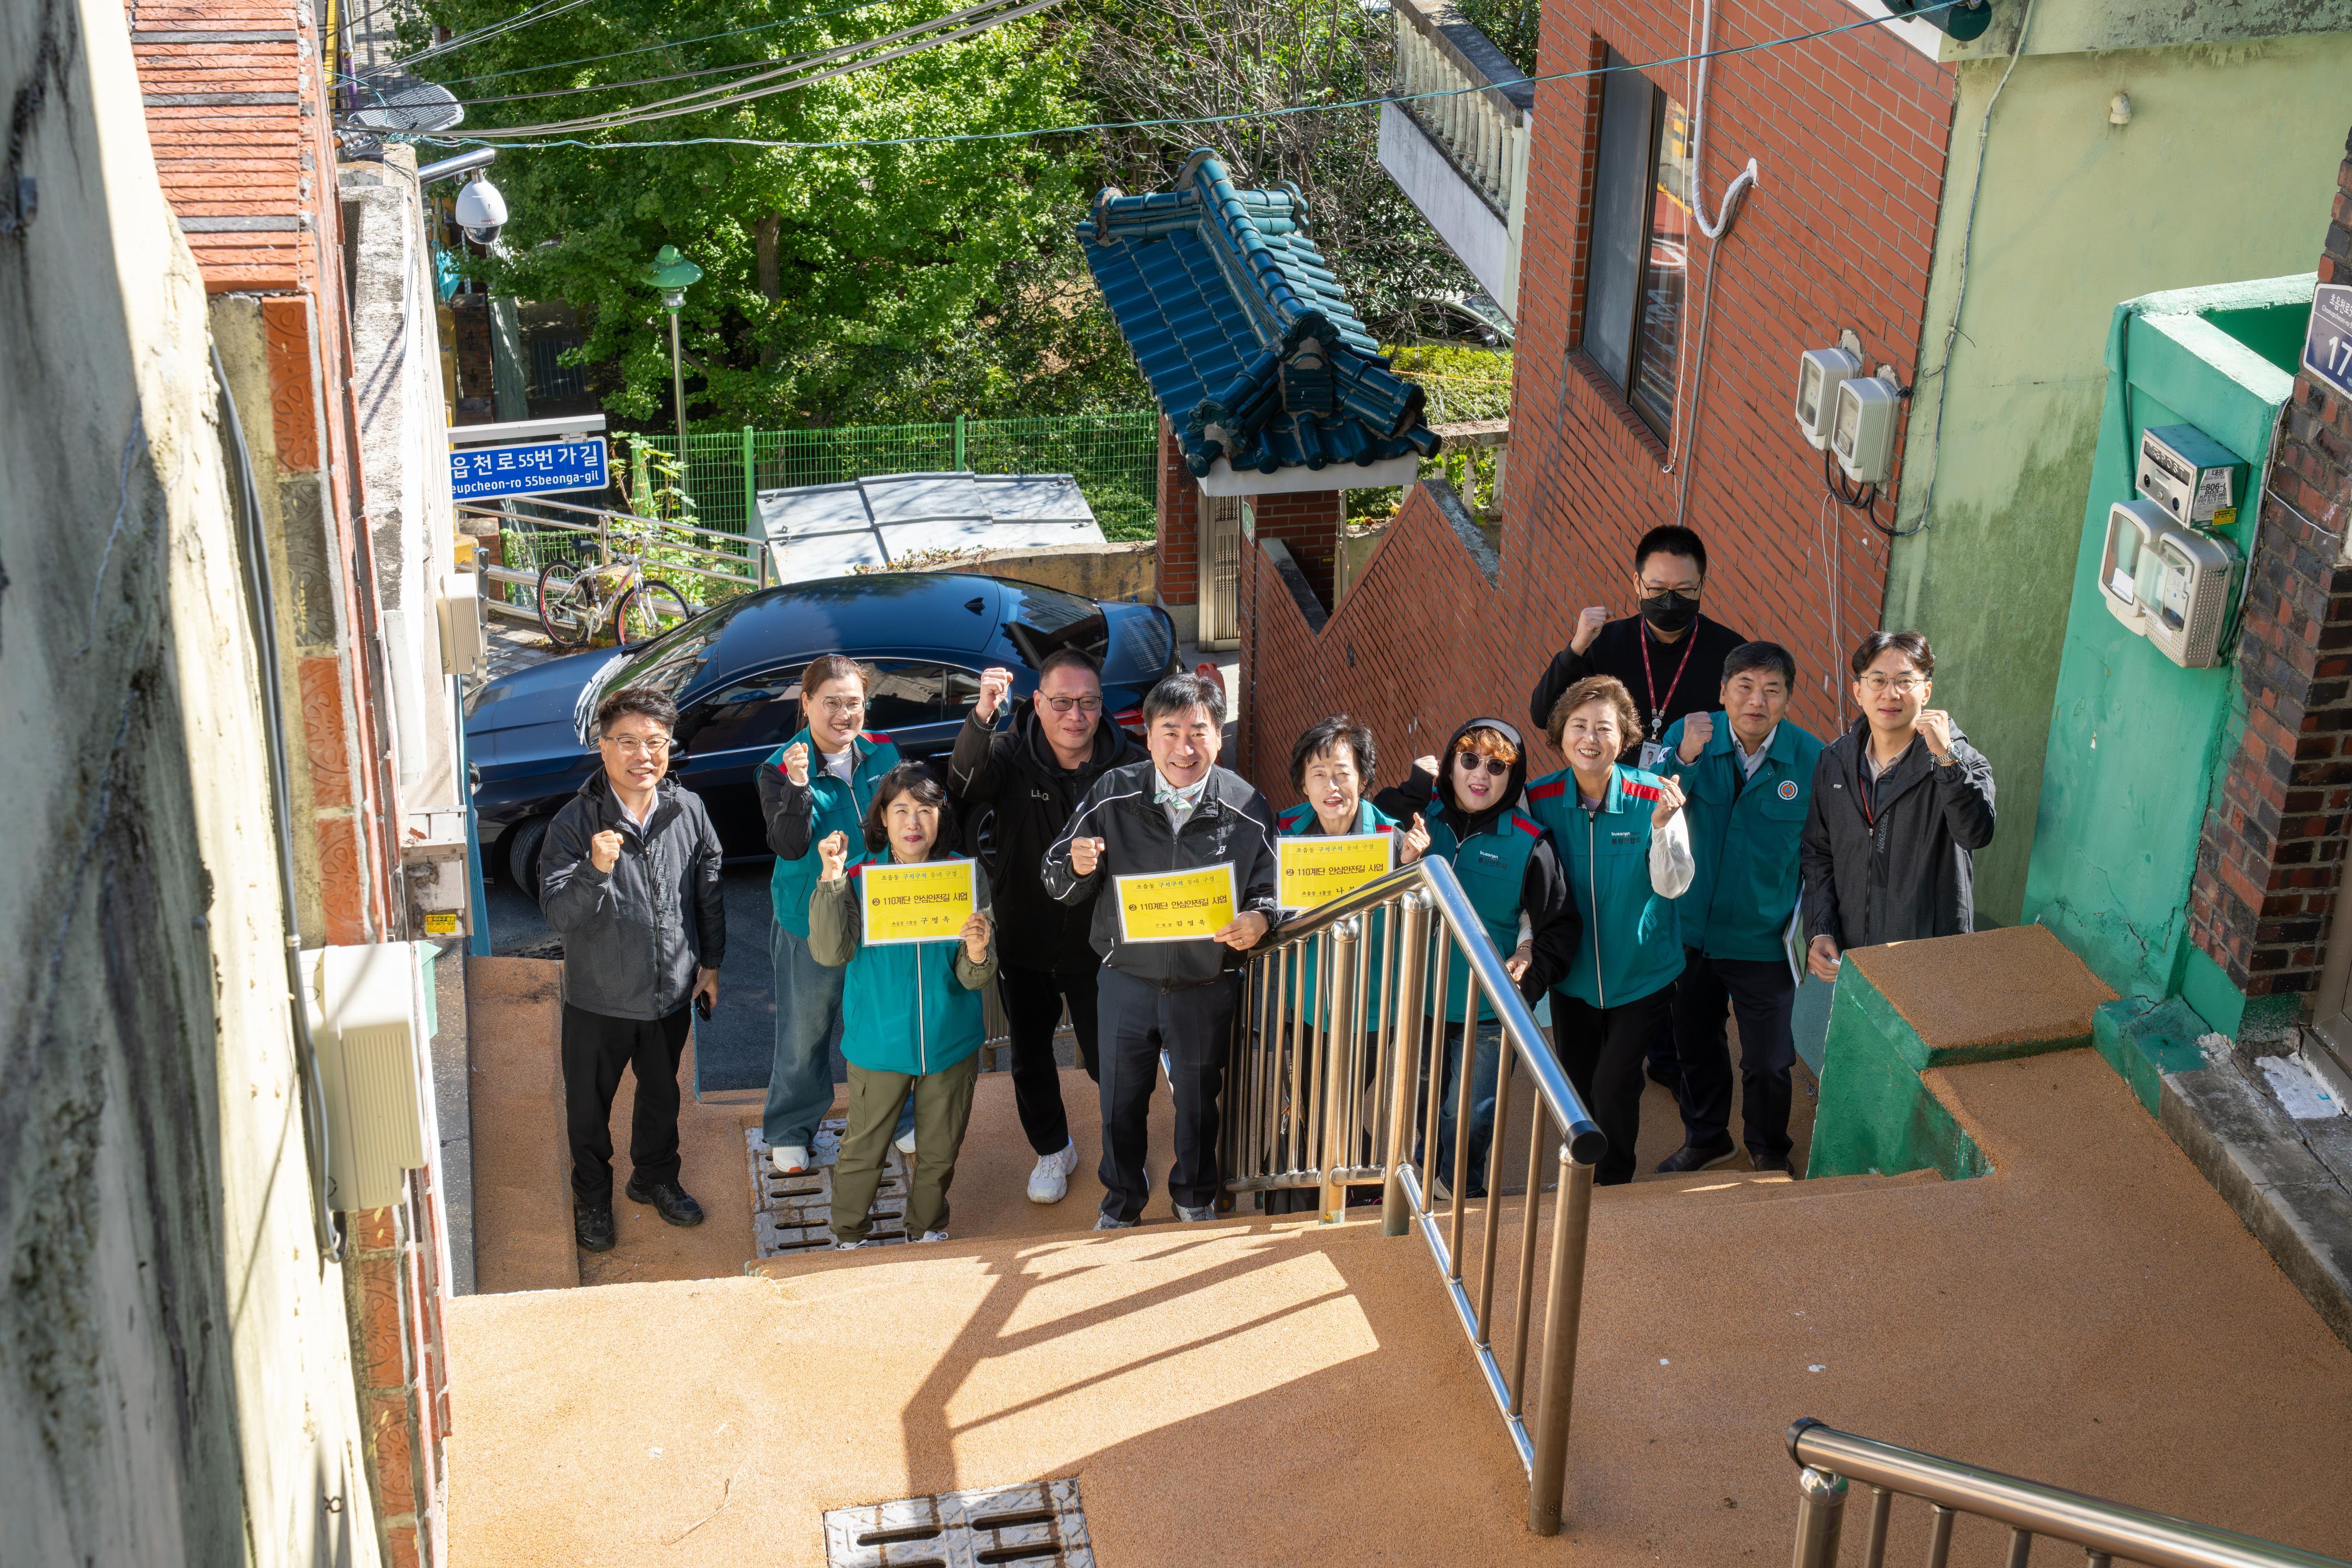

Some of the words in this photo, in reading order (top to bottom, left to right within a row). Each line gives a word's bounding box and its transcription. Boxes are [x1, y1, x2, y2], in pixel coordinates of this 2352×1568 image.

[2322, 305, 2350, 327] Choeupcheon-ro
[2328, 335, 2352, 377] 17
[2161, 452, 2184, 479] POST
[525, 470, 599, 487] 55beonga-gil
[1480, 850, 1498, 859] busanjin
[1297, 867, 1325, 876] 110계단
[1328, 865, 1365, 875] 안심안전길
[1368, 863, 1384, 872] 사업
[883, 896, 911, 905] 110계단
[914, 893, 950, 904] 안심안전길
[953, 892, 967, 902] 사업
[1140, 902, 1168, 910] 110계단
[1171, 898, 1209, 909] 안심안전길
[1212, 895, 1227, 904] 사업
